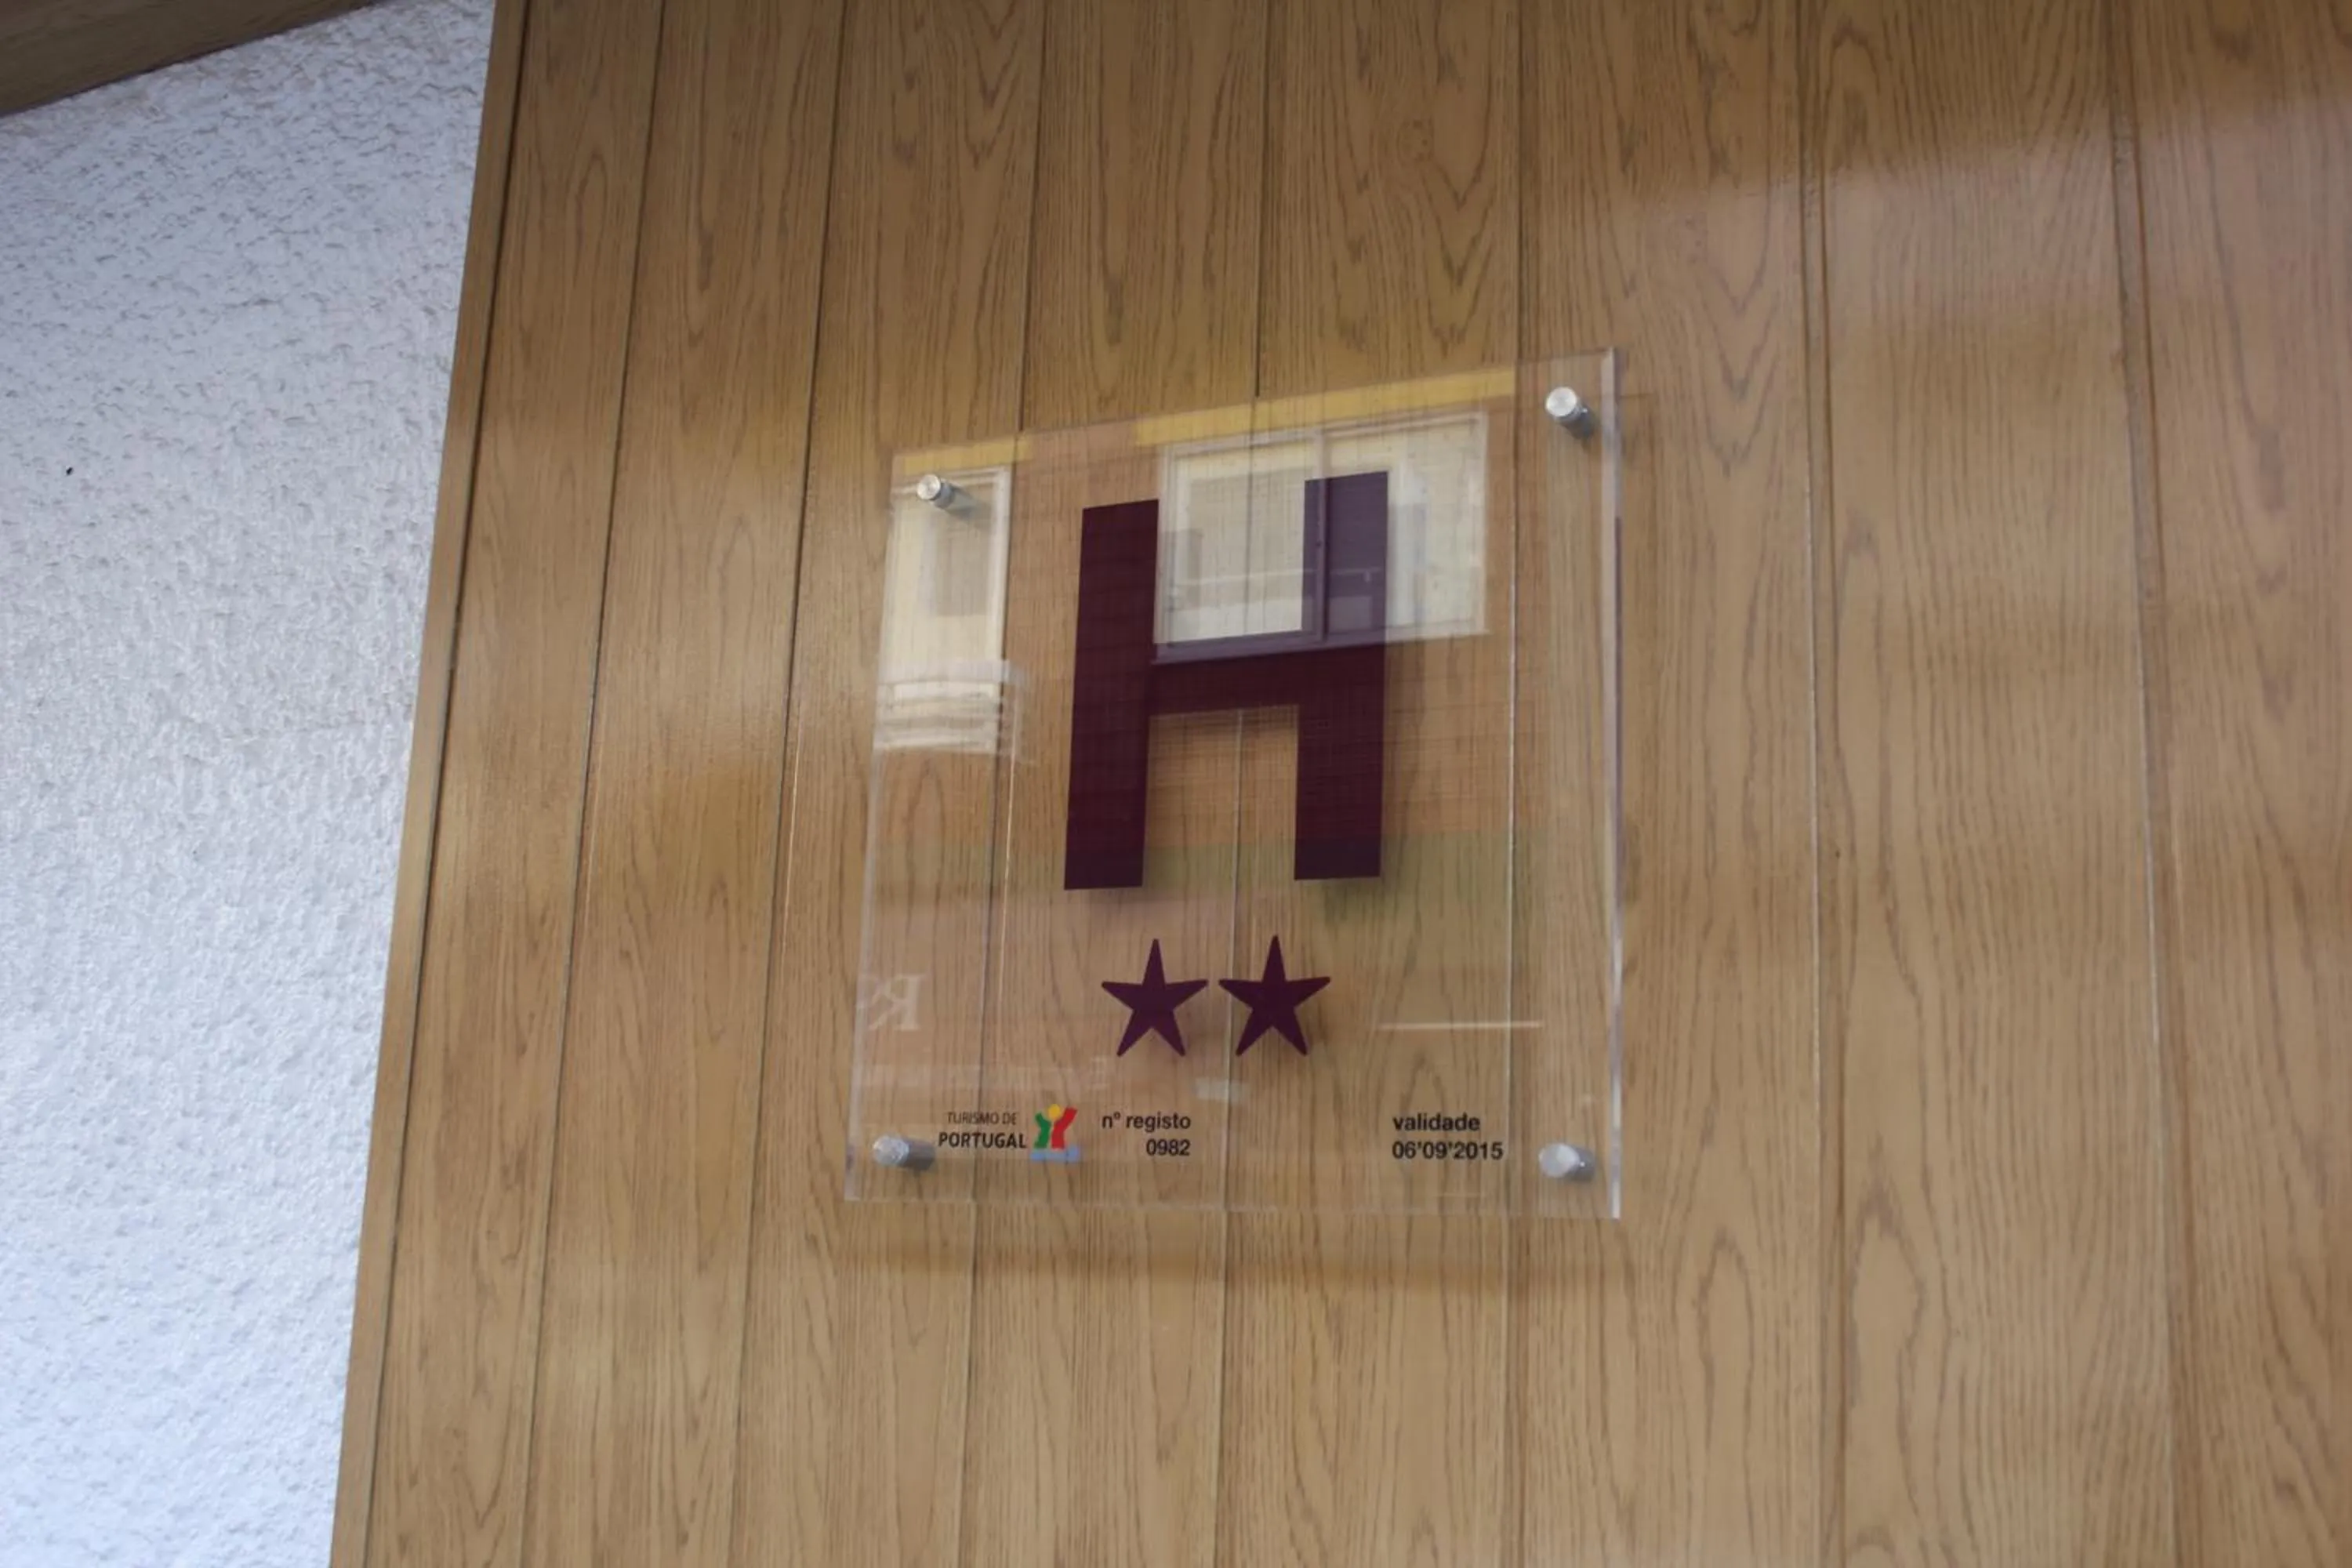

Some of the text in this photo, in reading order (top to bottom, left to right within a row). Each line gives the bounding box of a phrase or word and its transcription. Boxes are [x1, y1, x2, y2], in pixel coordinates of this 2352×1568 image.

[1065, 472, 1388, 890] H
[948, 1112, 1017, 1125] TURISMO DE
[1126, 1112, 1191, 1132] registo
[1392, 1112, 1480, 1131] validade
[938, 1132, 1026, 1149] PORTUGAL
[1146, 1139, 1190, 1156] 0982
[1392, 1141, 1504, 1160] 06'09'2015
